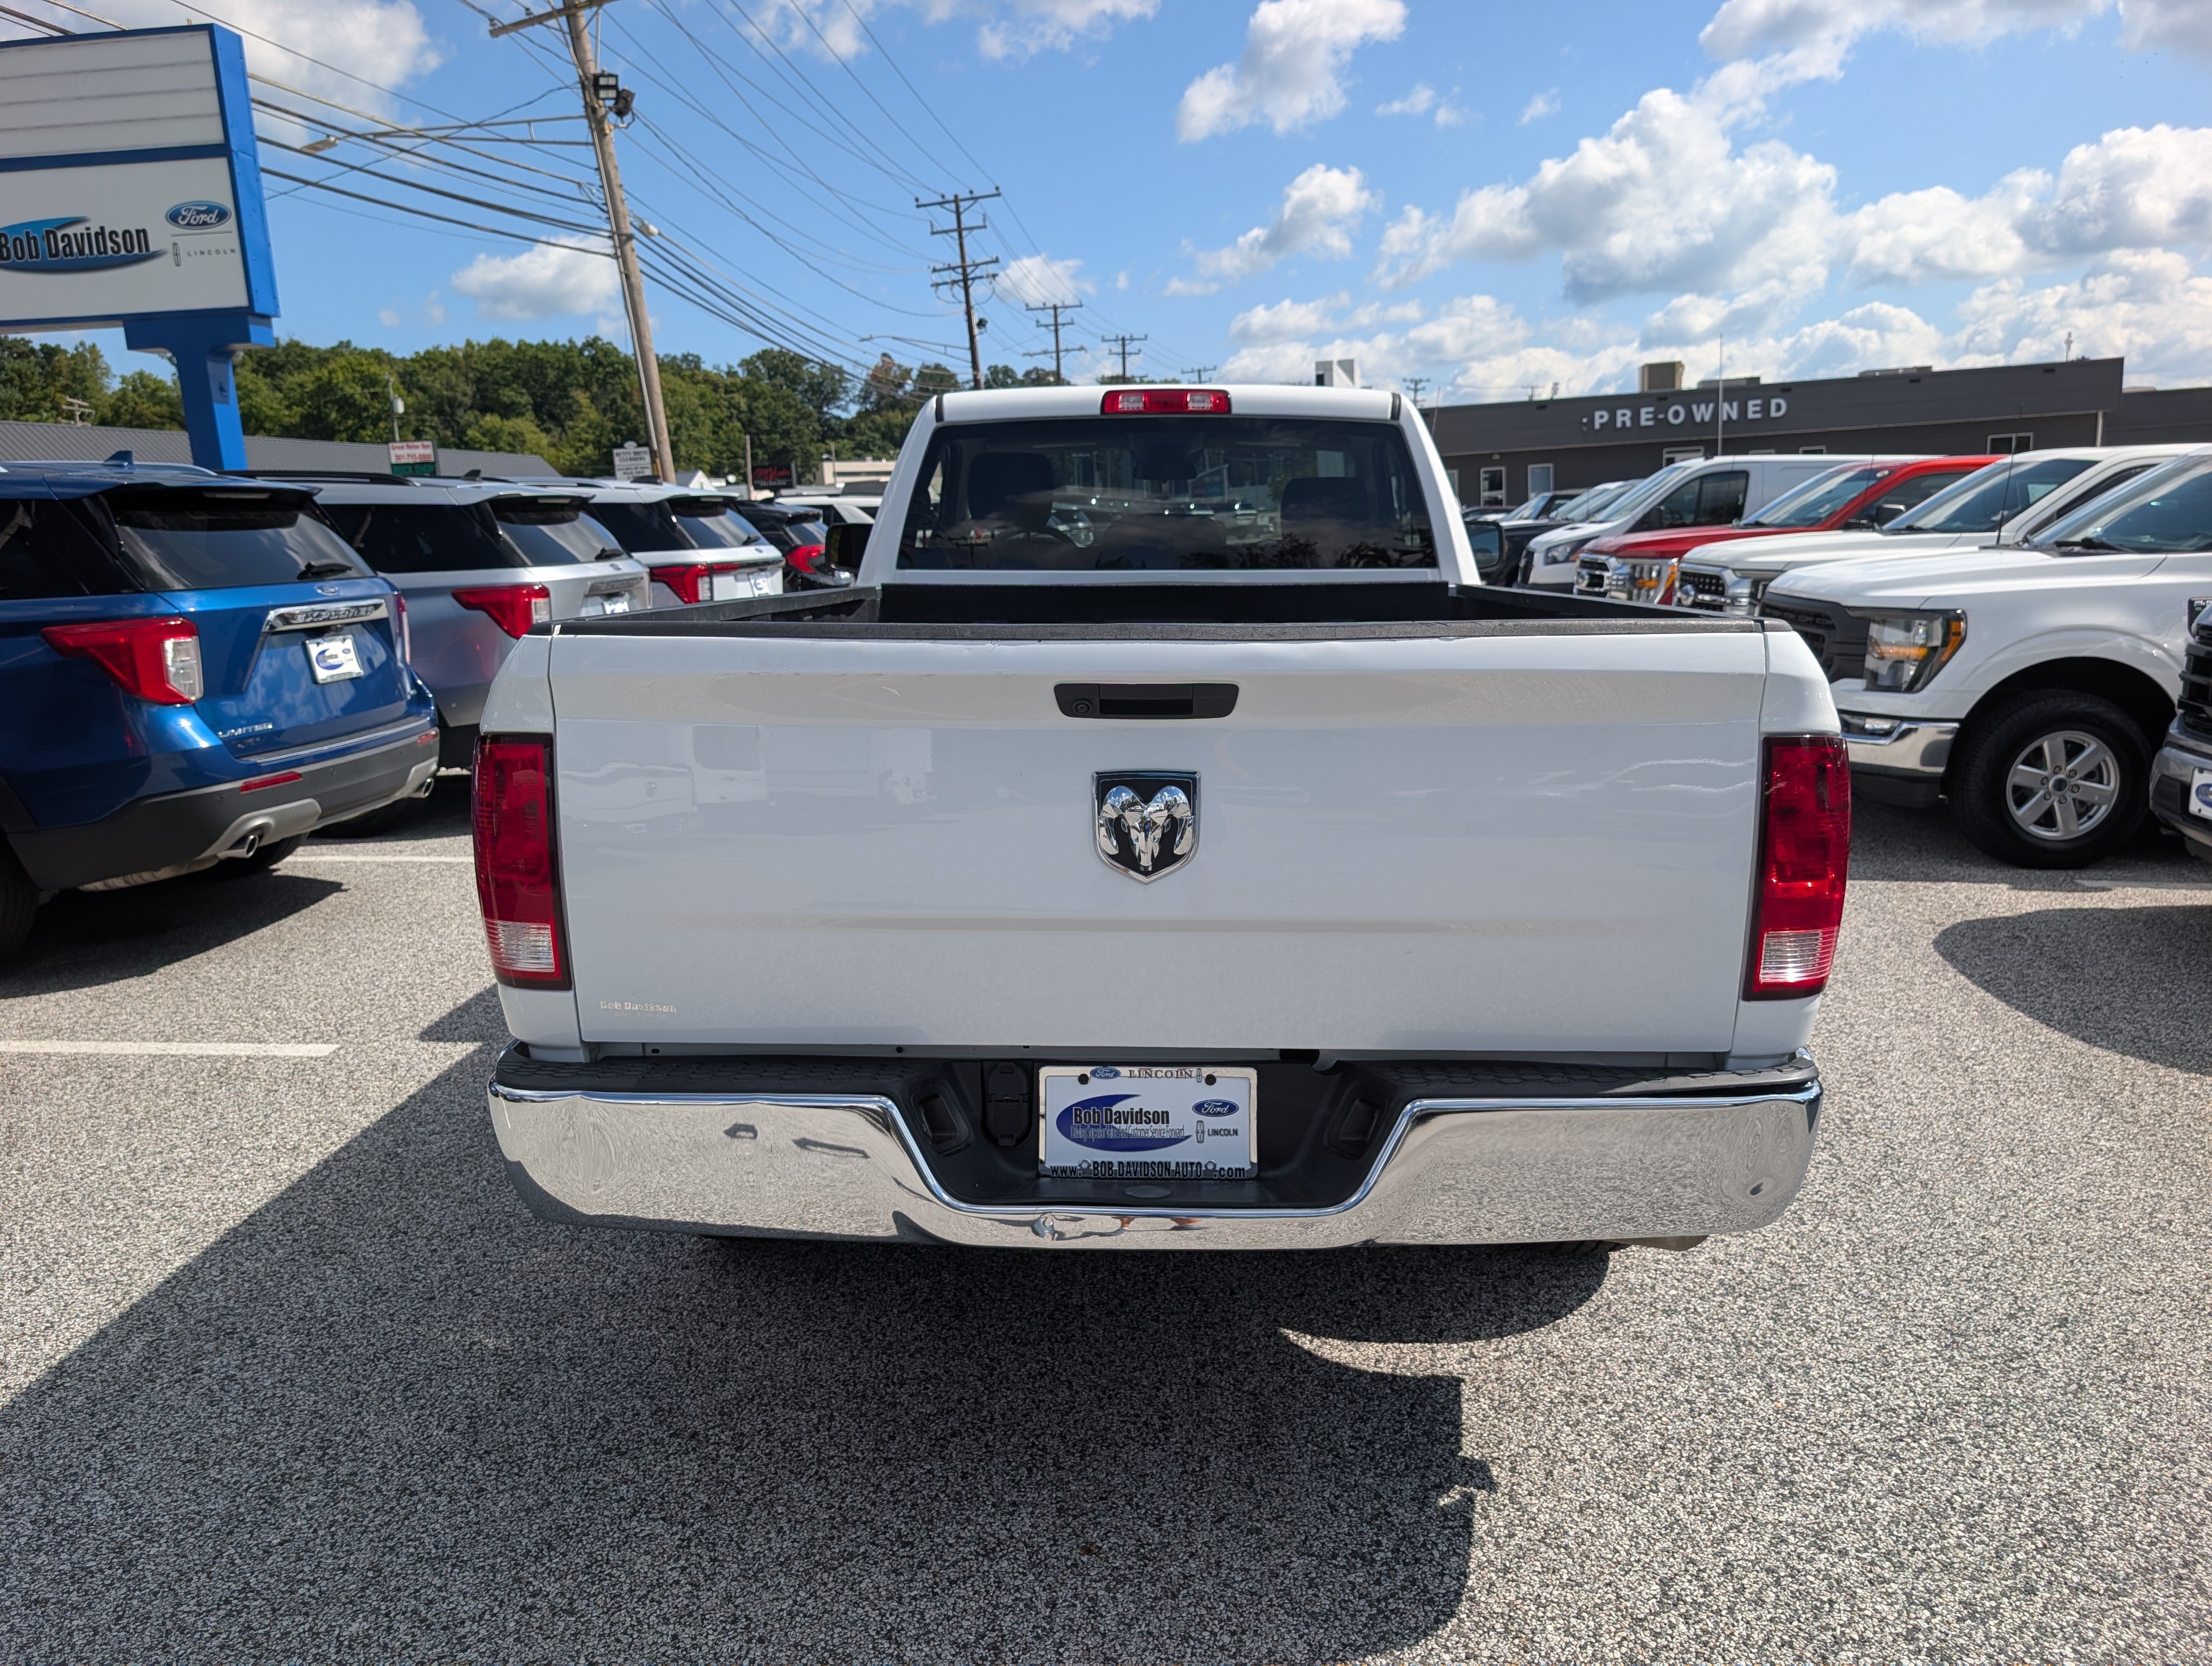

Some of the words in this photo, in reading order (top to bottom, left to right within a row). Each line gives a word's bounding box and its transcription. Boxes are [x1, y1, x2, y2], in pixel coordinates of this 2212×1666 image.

[178, 206, 220, 225] Ford
[0, 230, 41, 261] Bob
[44, 226, 151, 259] Davidson
[187, 248, 236, 257] LINCOLN
[1593, 398, 1787, 430] PRE-OWNED
[293, 605, 375, 623] EXPLORER
[600, 1001, 622, 1010] Bob
[624, 1001, 677, 1013] Davidson
[1128, 1069, 1193, 1079] LINCOLN
[1201, 1101, 1230, 1114] Ford
[1073, 1107, 1102, 1125] Bob
[1104, 1107, 1171, 1125] Davidson
[1128, 1125, 1149, 1138] Customer
[1149, 1125, 1166, 1138] Service
[1166, 1124, 1185, 1138] Forward
[1207, 1128, 1239, 1137] LINCOLN
[1092, 1161, 1114, 1177] BOB
[1117, 1161, 1171, 1177] DAVIDSON
[1174, 1161, 1203, 1178] AUTO
